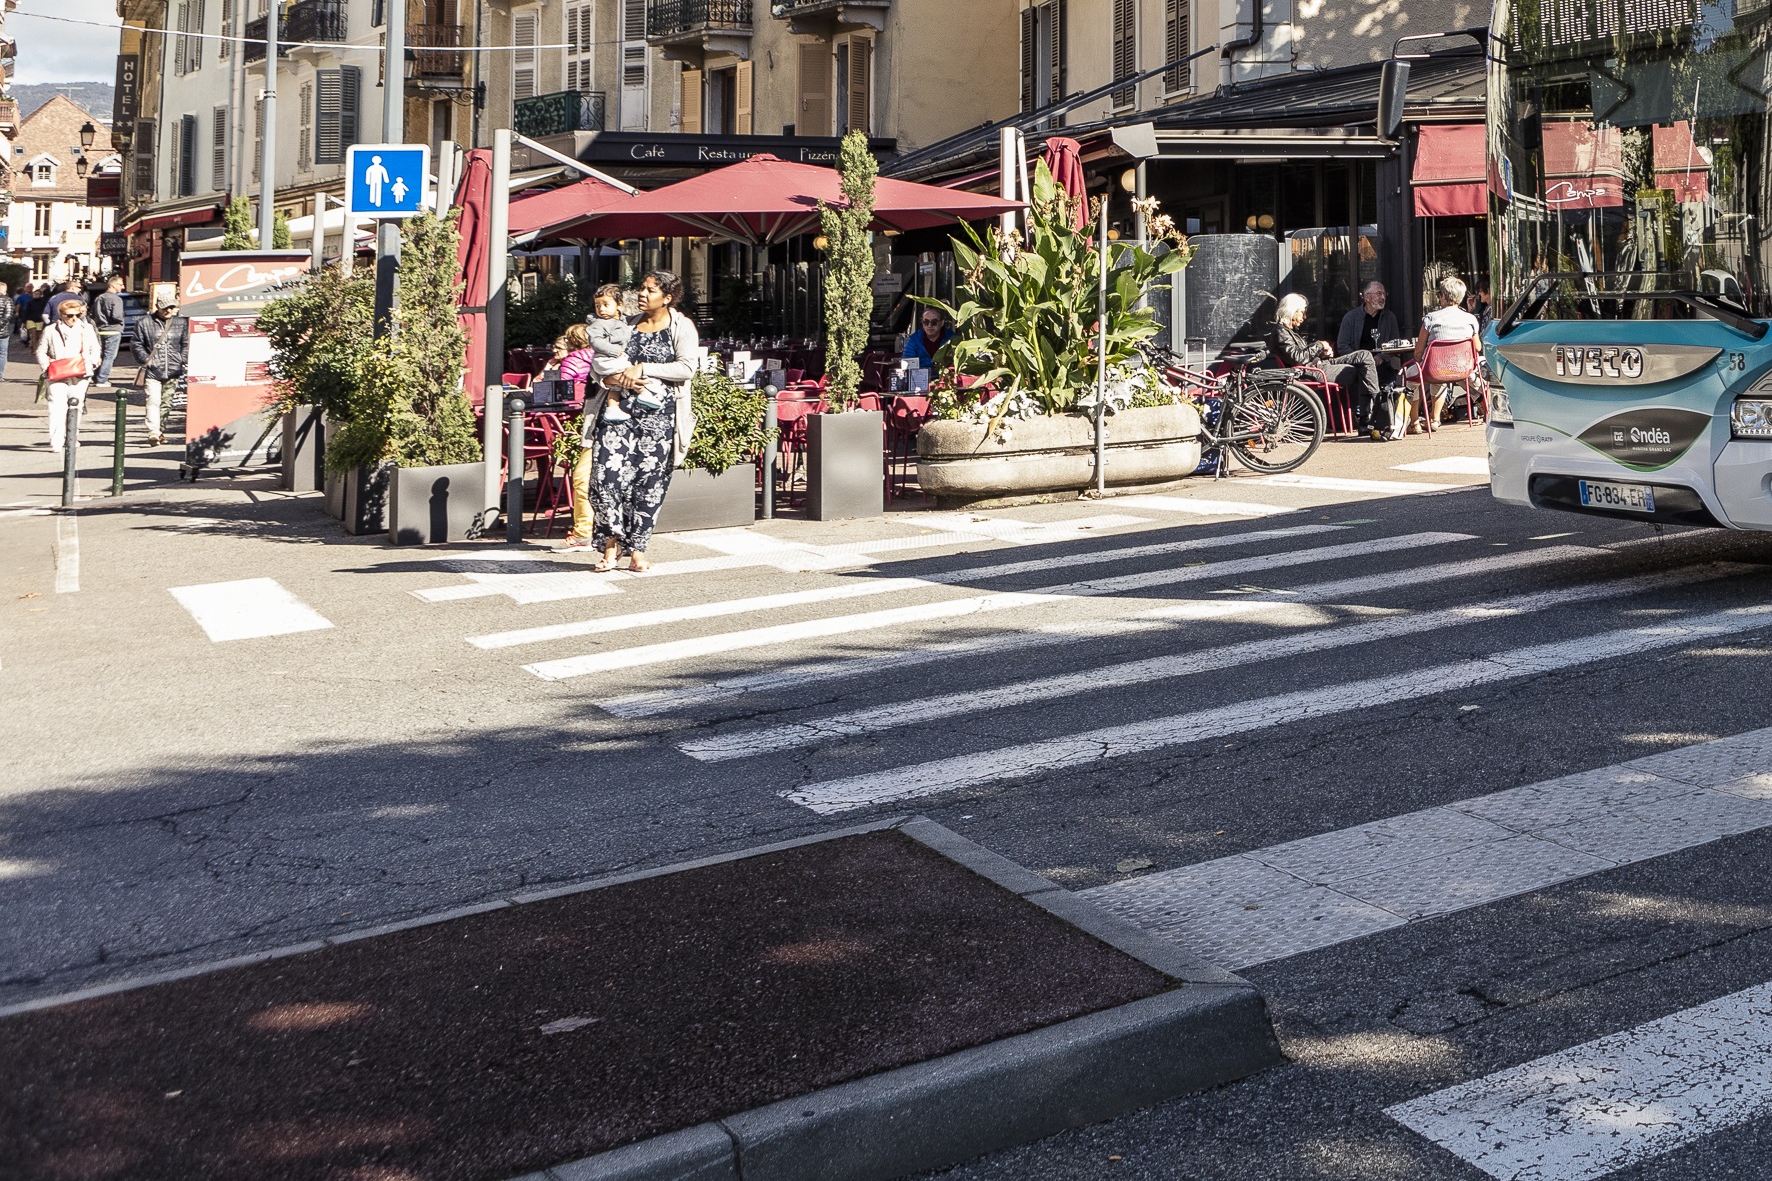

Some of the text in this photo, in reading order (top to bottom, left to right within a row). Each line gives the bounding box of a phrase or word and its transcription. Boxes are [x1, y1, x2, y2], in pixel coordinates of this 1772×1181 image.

[122, 61, 134, 115] HOTEL
[630, 144, 665, 160] Café
[698, 146, 758, 160] Restaur
[185, 270, 214, 297] Le
[1556, 347, 1644, 378] IVECO
[1729, 352, 1746, 372] 58
[1630, 427, 1671, 444] Ondéa
[1586, 484, 1647, 508] FG-834-ER
